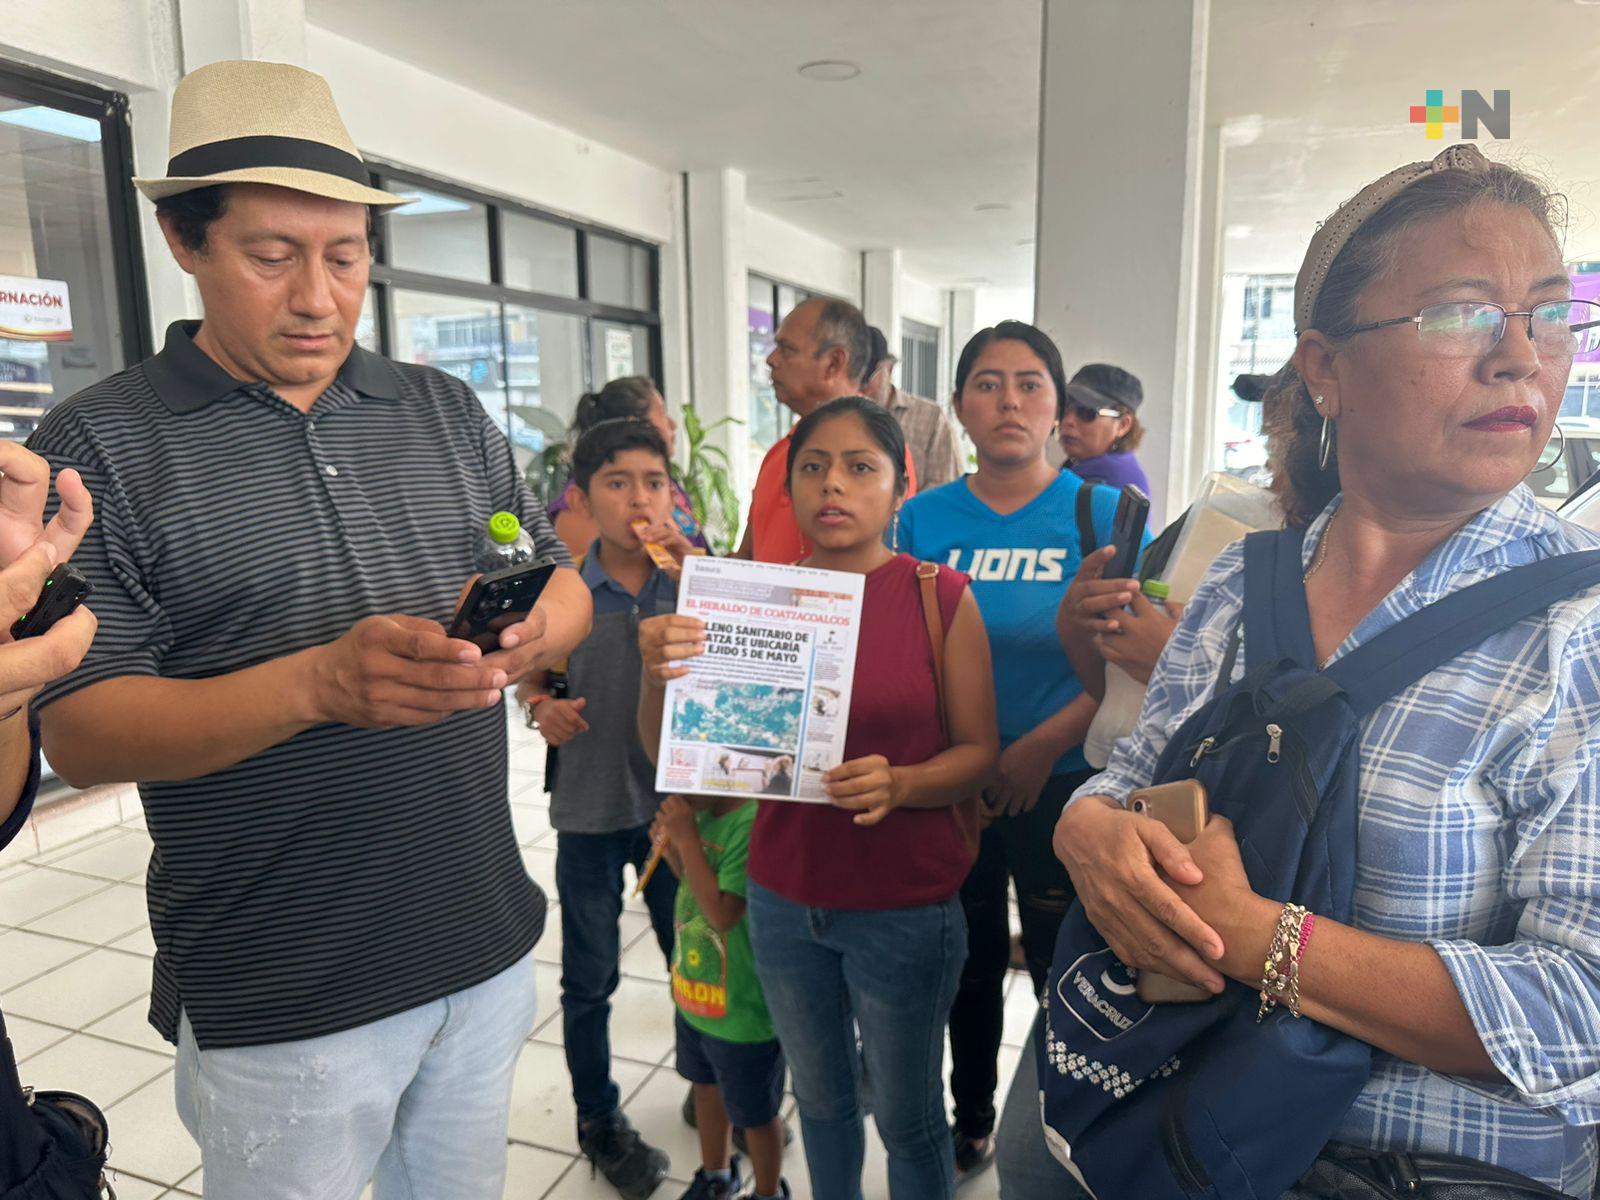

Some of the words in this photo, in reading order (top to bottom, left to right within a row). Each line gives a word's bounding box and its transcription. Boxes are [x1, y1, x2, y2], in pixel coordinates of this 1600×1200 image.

[686, 600, 697, 609] EL
[699, 600, 747, 614] HERALDO
[749, 607, 763, 618] DE
[764, 608, 851, 627] COATZACOALCOS
[735, 625, 792, 641] SANITARIO
[795, 632, 809, 643] DE
[708, 644, 739, 657] EJIDO
[750, 649, 764, 660] DE
[766, 651, 798, 664] MAYO
[735, 636, 748, 647] SE
[750, 638, 800, 653] UBICARÍA
[1073, 970, 1134, 1030] VERACRUZ
